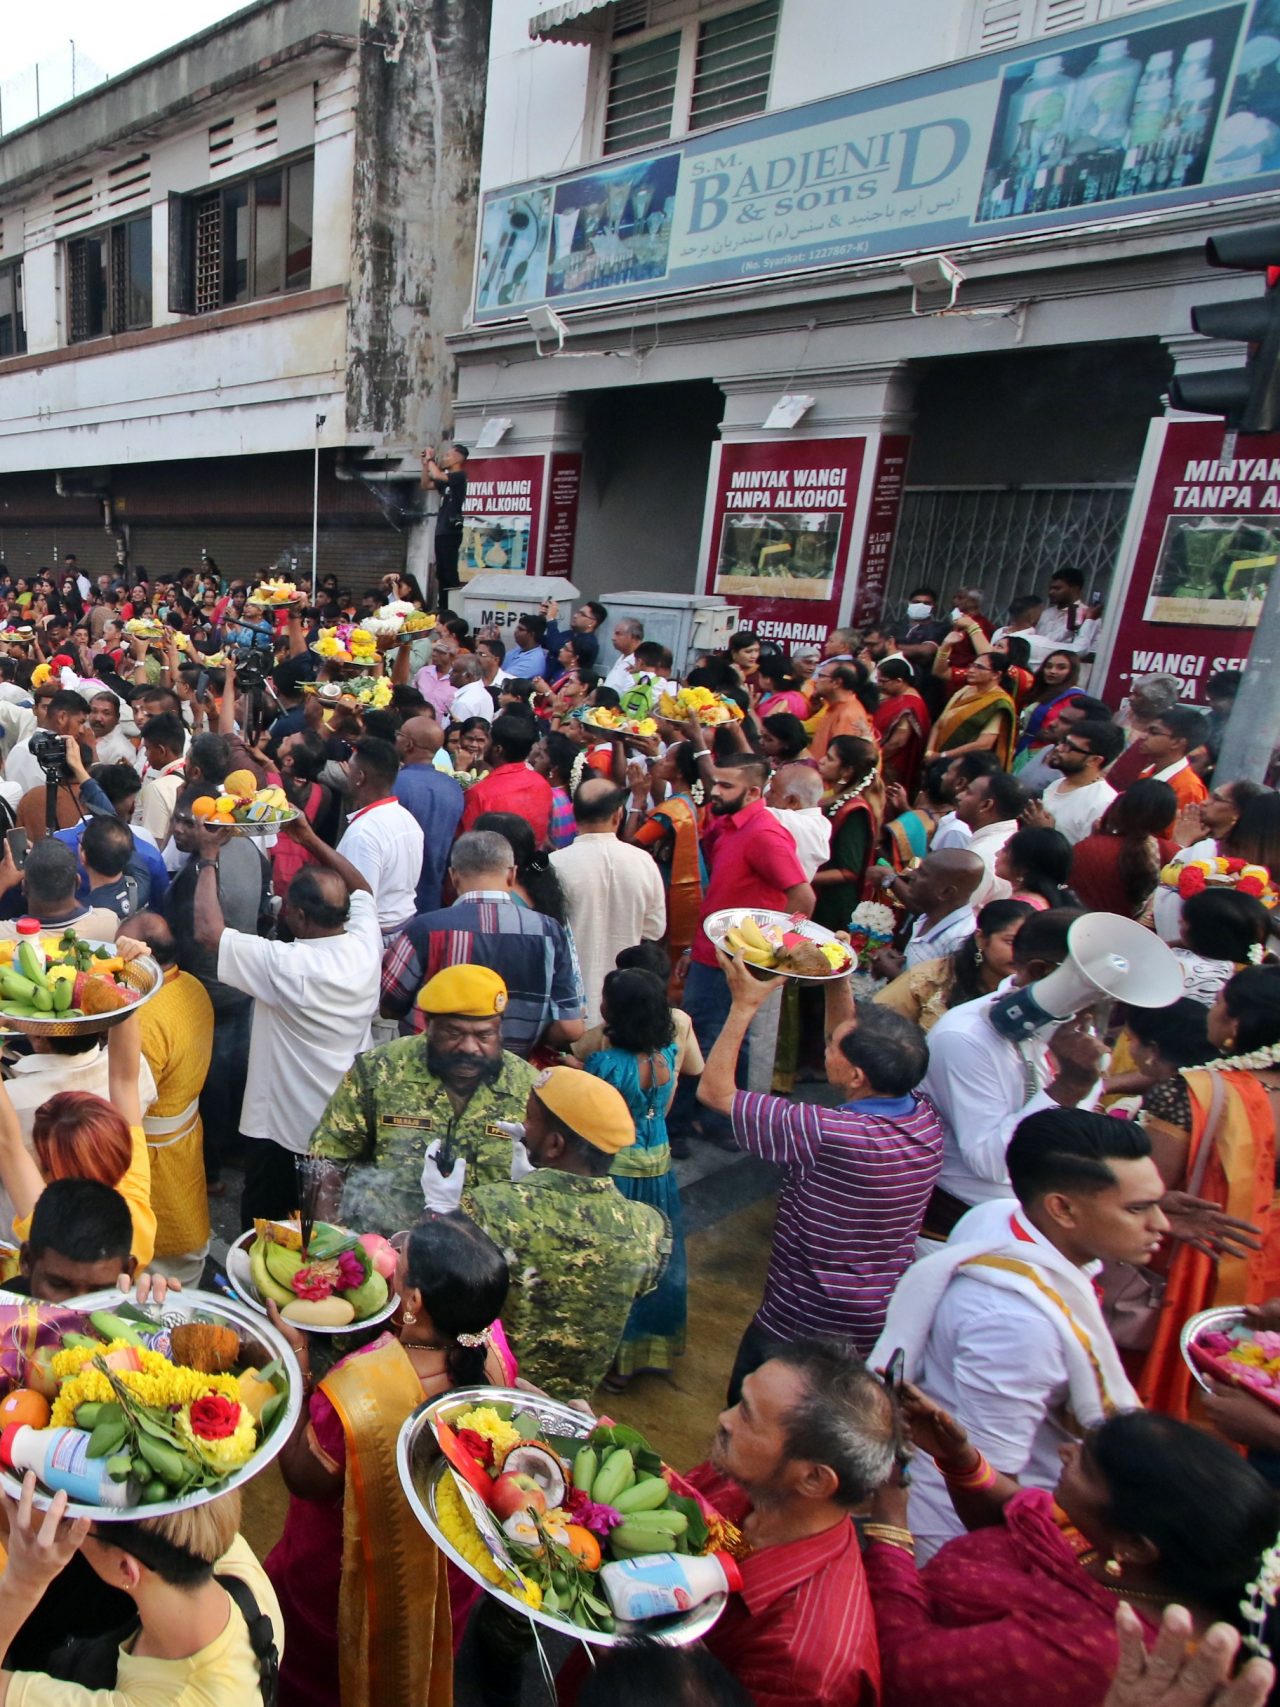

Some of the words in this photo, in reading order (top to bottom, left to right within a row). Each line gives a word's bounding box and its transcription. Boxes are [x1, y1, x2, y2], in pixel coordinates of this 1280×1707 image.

[691, 153, 743, 177] S.M.
[735, 203, 767, 224] &
[774, 179, 878, 217] sons
[466, 481, 495, 496] INYAK
[496, 479, 532, 495] WANGI
[731, 470, 790, 489] MINYAK
[793, 467, 848, 487] WANGI
[486, 497, 533, 512] ALKOHOL
[726, 491, 771, 509] TANPA
[774, 489, 848, 508] ALKOHOL
[1173, 486, 1252, 508] TANPA
[755, 620, 828, 642] SEHARIAN
[1131, 650, 1206, 676] WANGI
